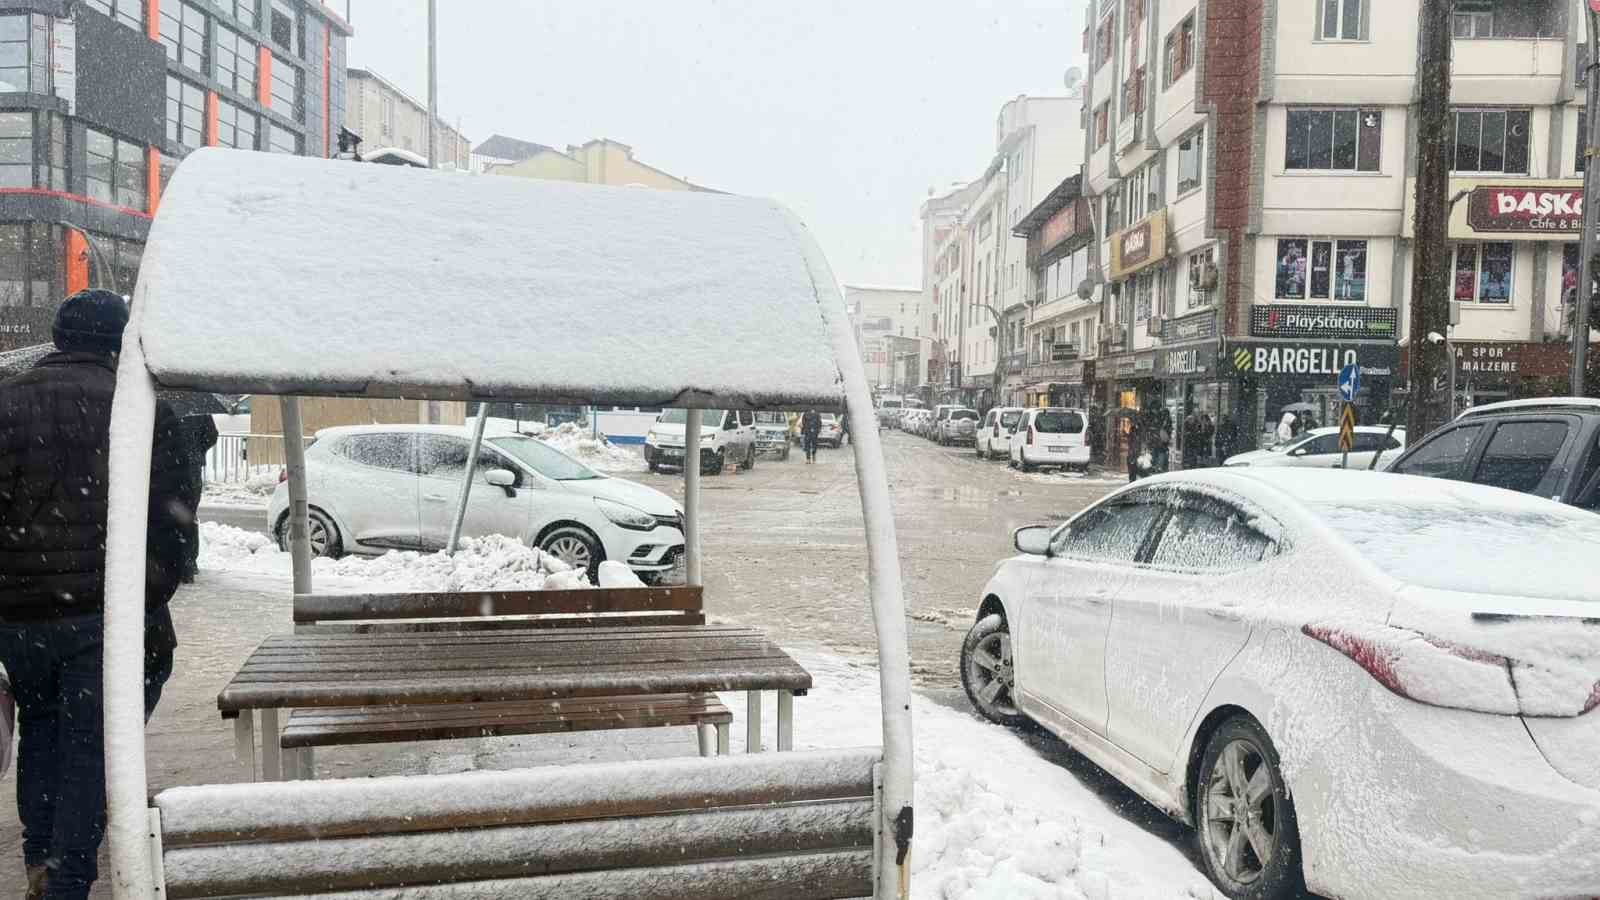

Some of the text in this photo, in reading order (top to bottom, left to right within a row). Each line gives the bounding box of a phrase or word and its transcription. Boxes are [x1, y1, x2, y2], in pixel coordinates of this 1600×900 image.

[1529, 218, 1556, 229] Cafe
[1559, 219, 1568, 229] &
[1286, 313, 1364, 331] PlayStation
[1472, 347, 1504, 358] SPOR
[1254, 347, 1357, 374] BARGELLO
[1462, 361, 1517, 372] MALZEME
